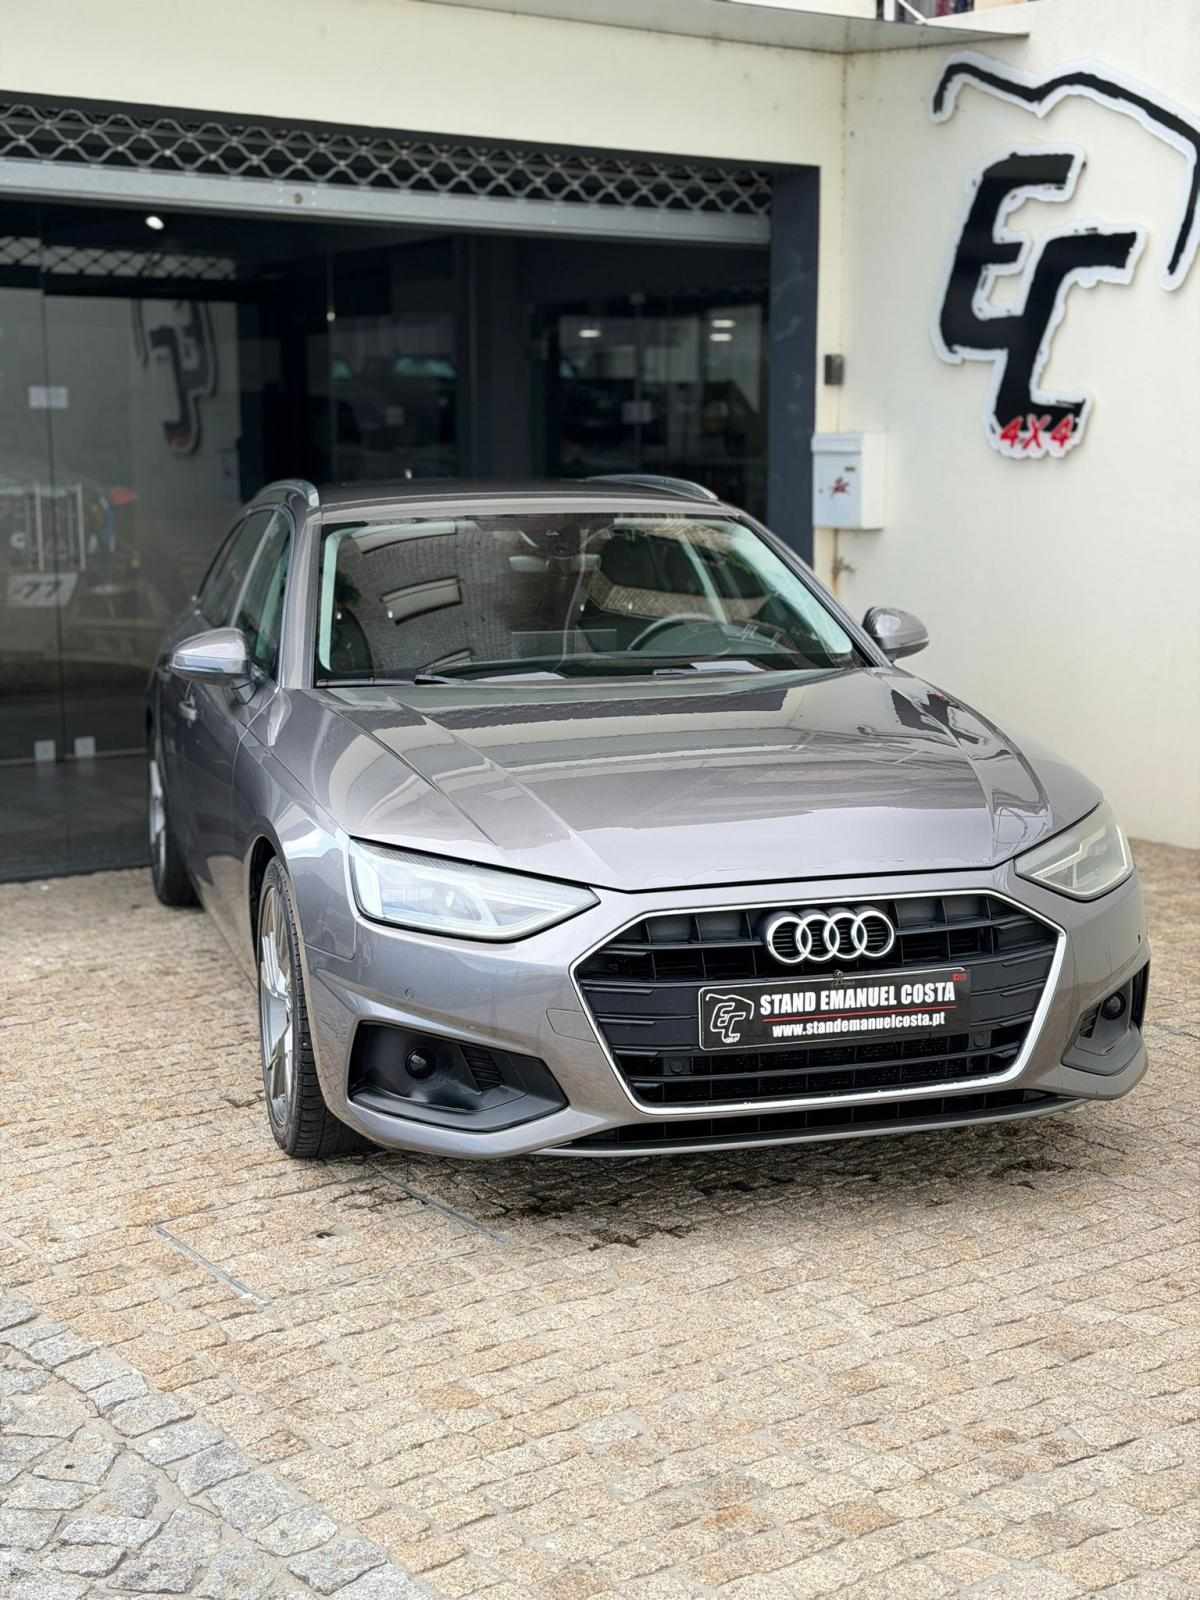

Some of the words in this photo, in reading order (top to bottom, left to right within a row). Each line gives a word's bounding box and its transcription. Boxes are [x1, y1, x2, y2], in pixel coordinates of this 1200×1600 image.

[760, 991, 816, 1016] STAND
[820, 985, 897, 1011] EMANUEL
[901, 981, 956, 1005] COSTA
[772, 1011, 945, 1038] www.standemanuelcosta.pt
